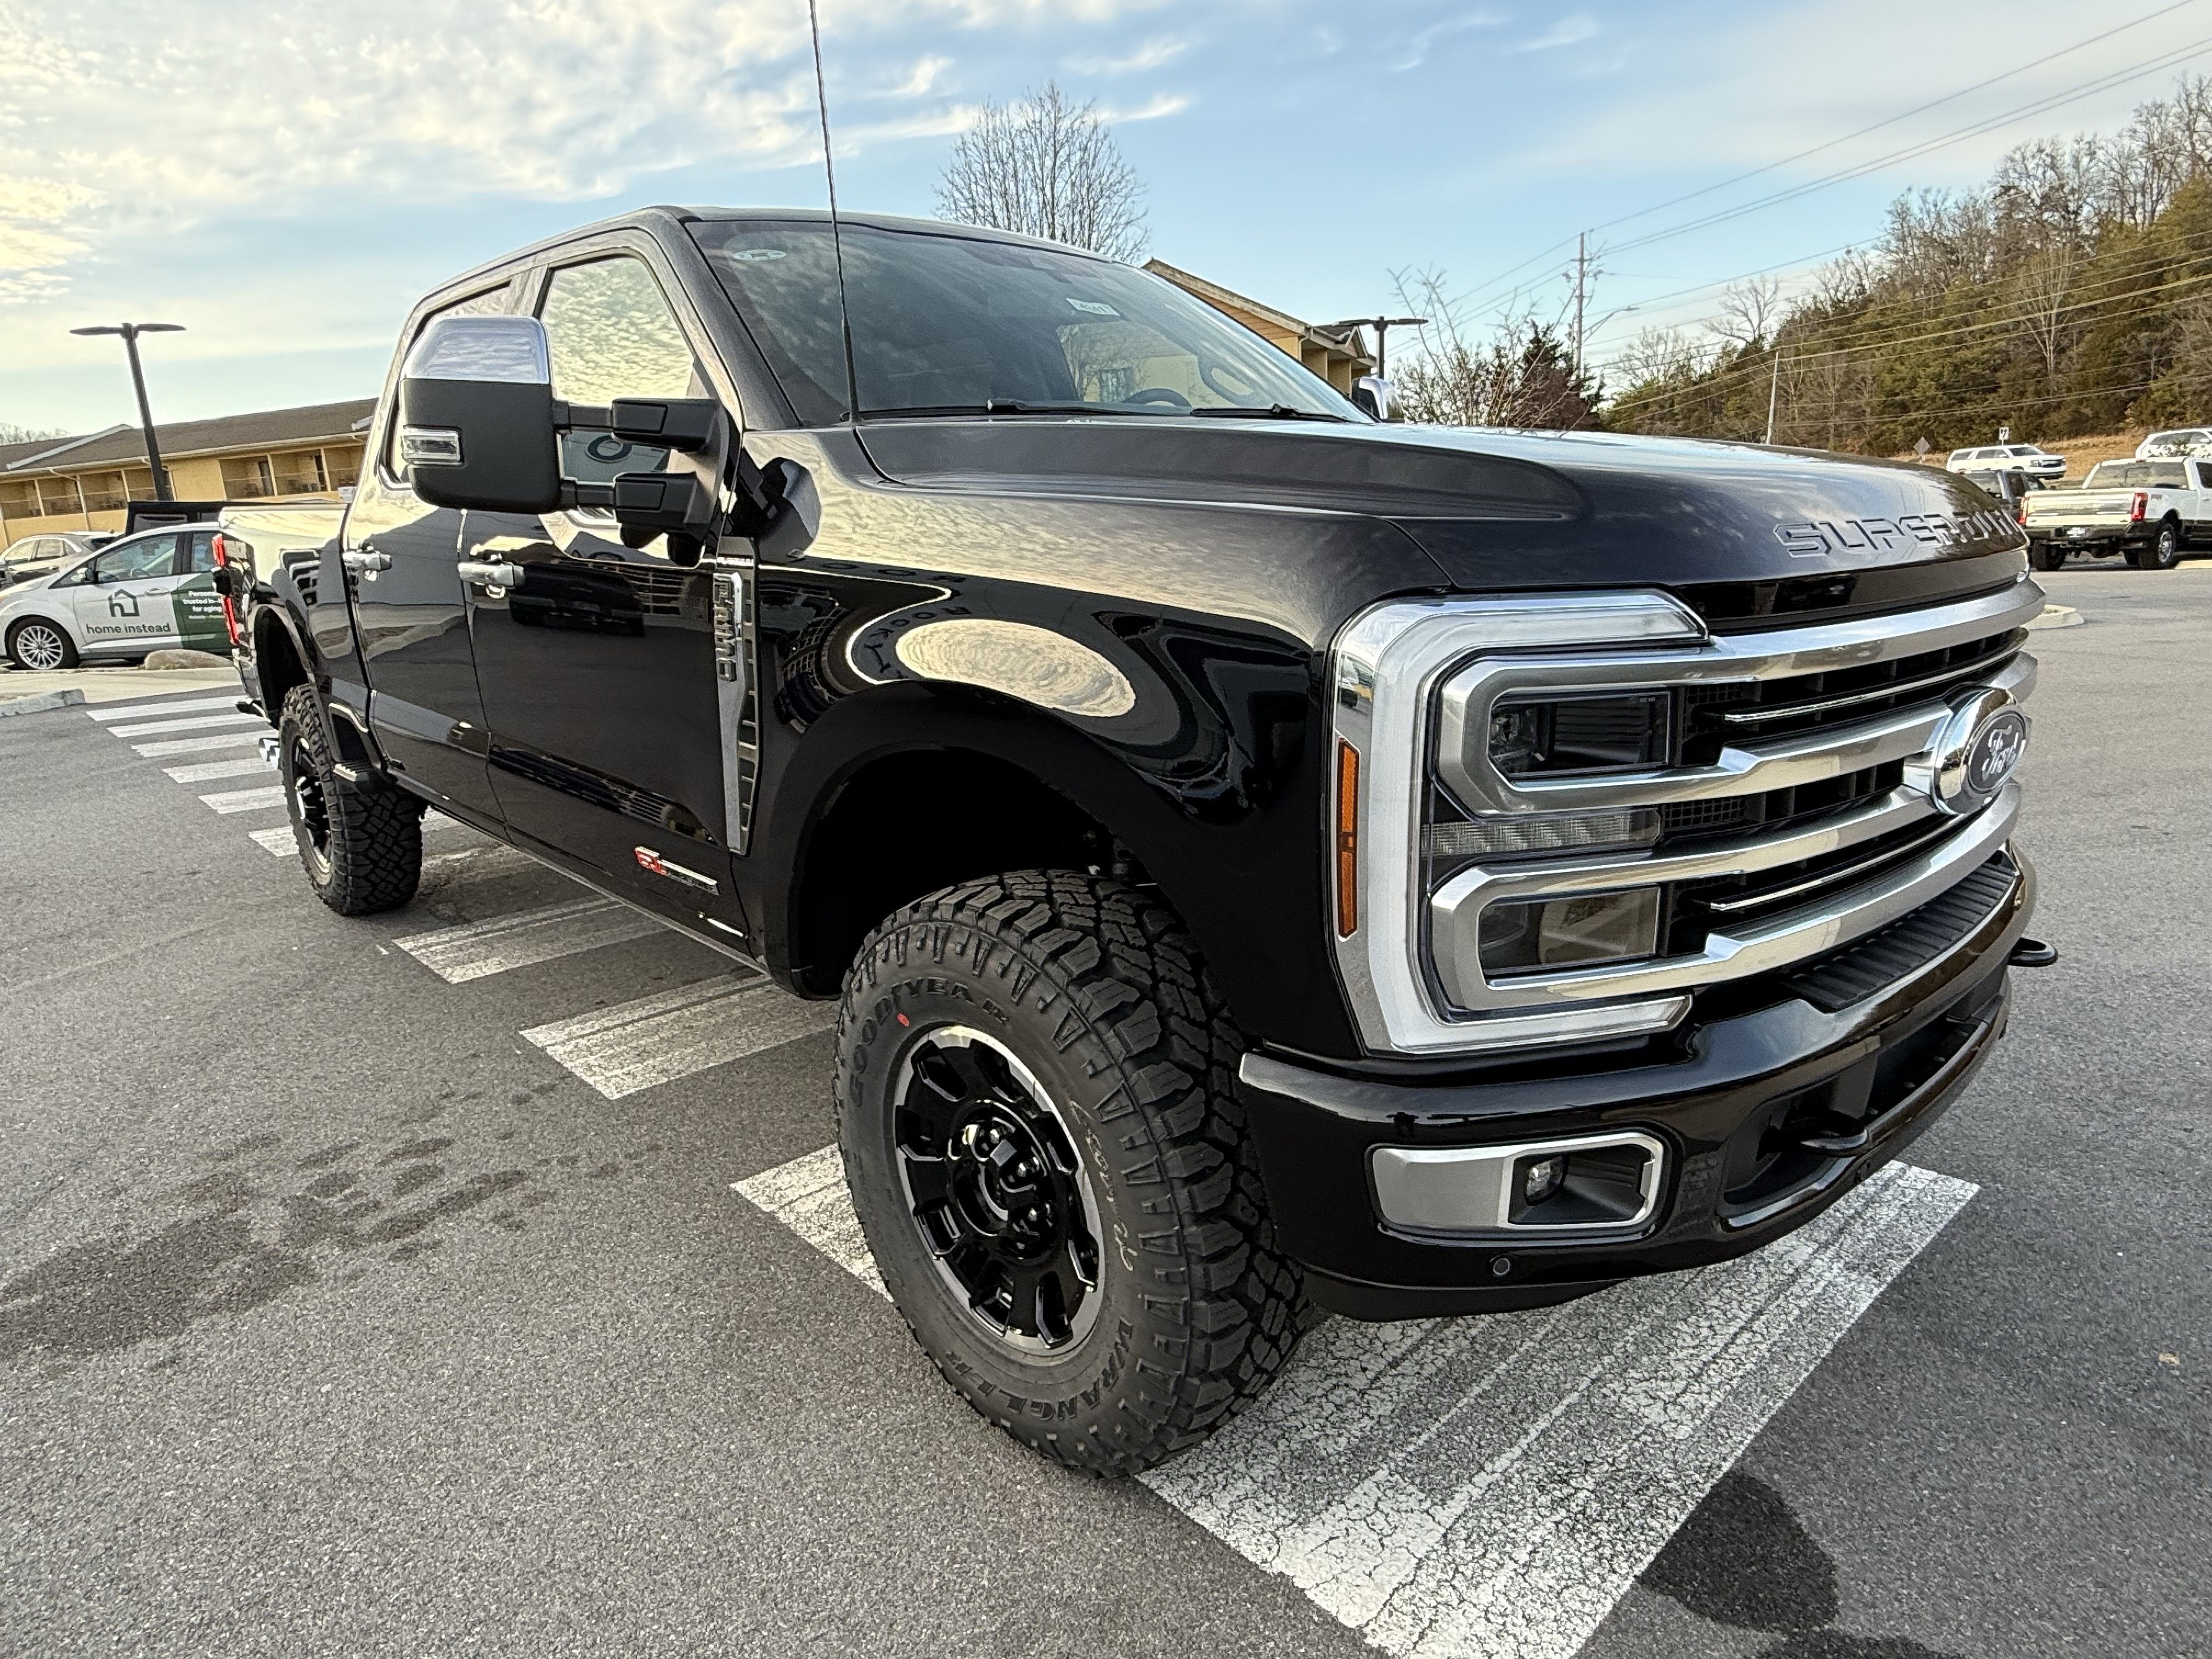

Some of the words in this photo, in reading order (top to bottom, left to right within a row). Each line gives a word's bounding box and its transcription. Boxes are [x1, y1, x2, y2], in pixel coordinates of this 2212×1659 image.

[1773, 512, 1968, 558] SUPER
[86, 623, 122, 634] home
[124, 622, 171, 633] instead
[1981, 724, 2020, 781] Ford
